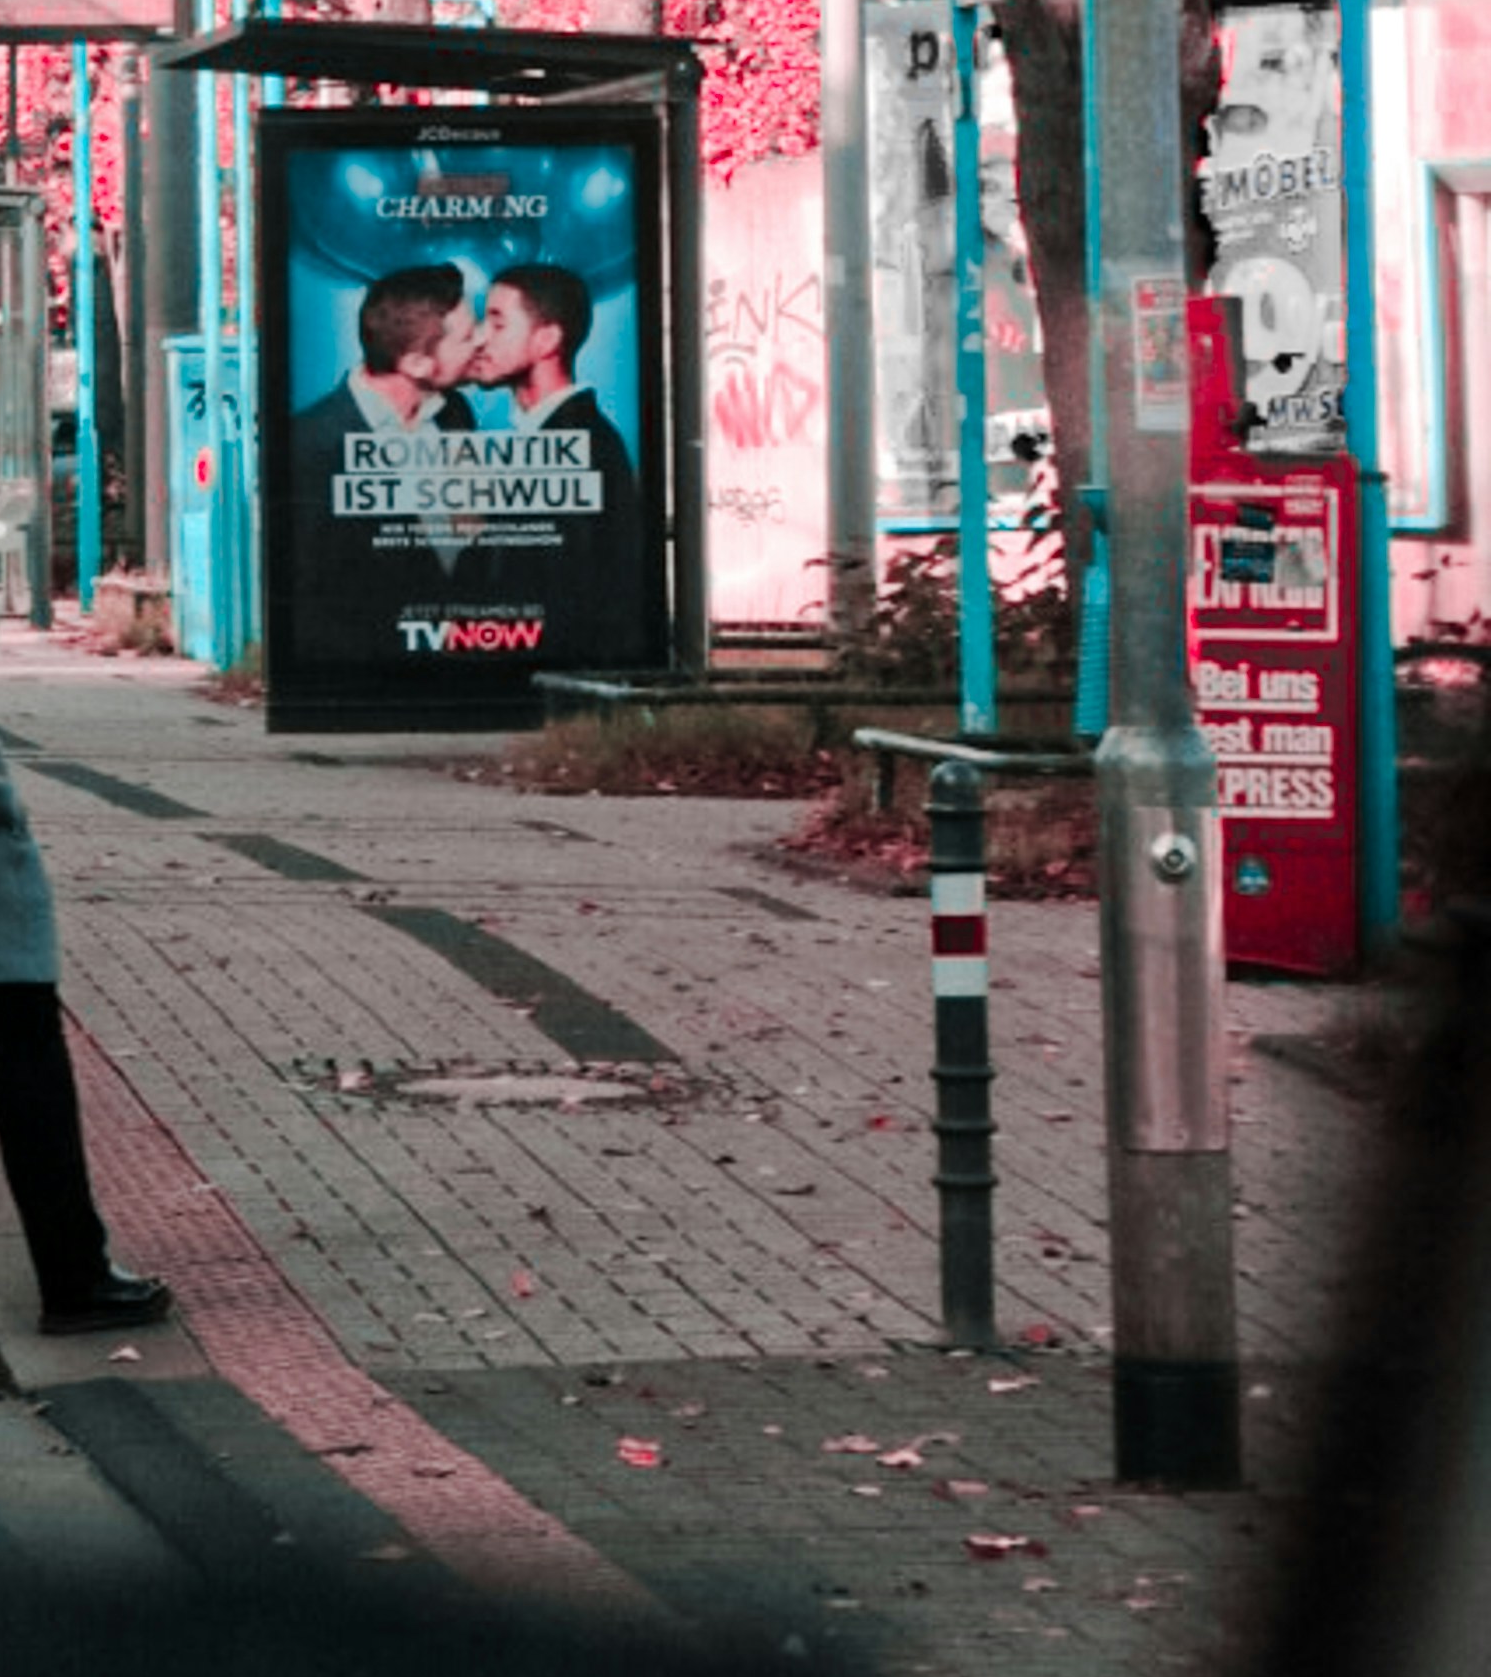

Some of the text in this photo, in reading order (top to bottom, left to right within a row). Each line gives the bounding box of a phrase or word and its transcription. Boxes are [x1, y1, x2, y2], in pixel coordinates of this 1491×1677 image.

[353, 436, 581, 468] ROMANTIK
[344, 478, 592, 510] IST SCHWUL
[1199, 660, 1320, 699] Bei uns
[1262, 725, 1333, 753] man
